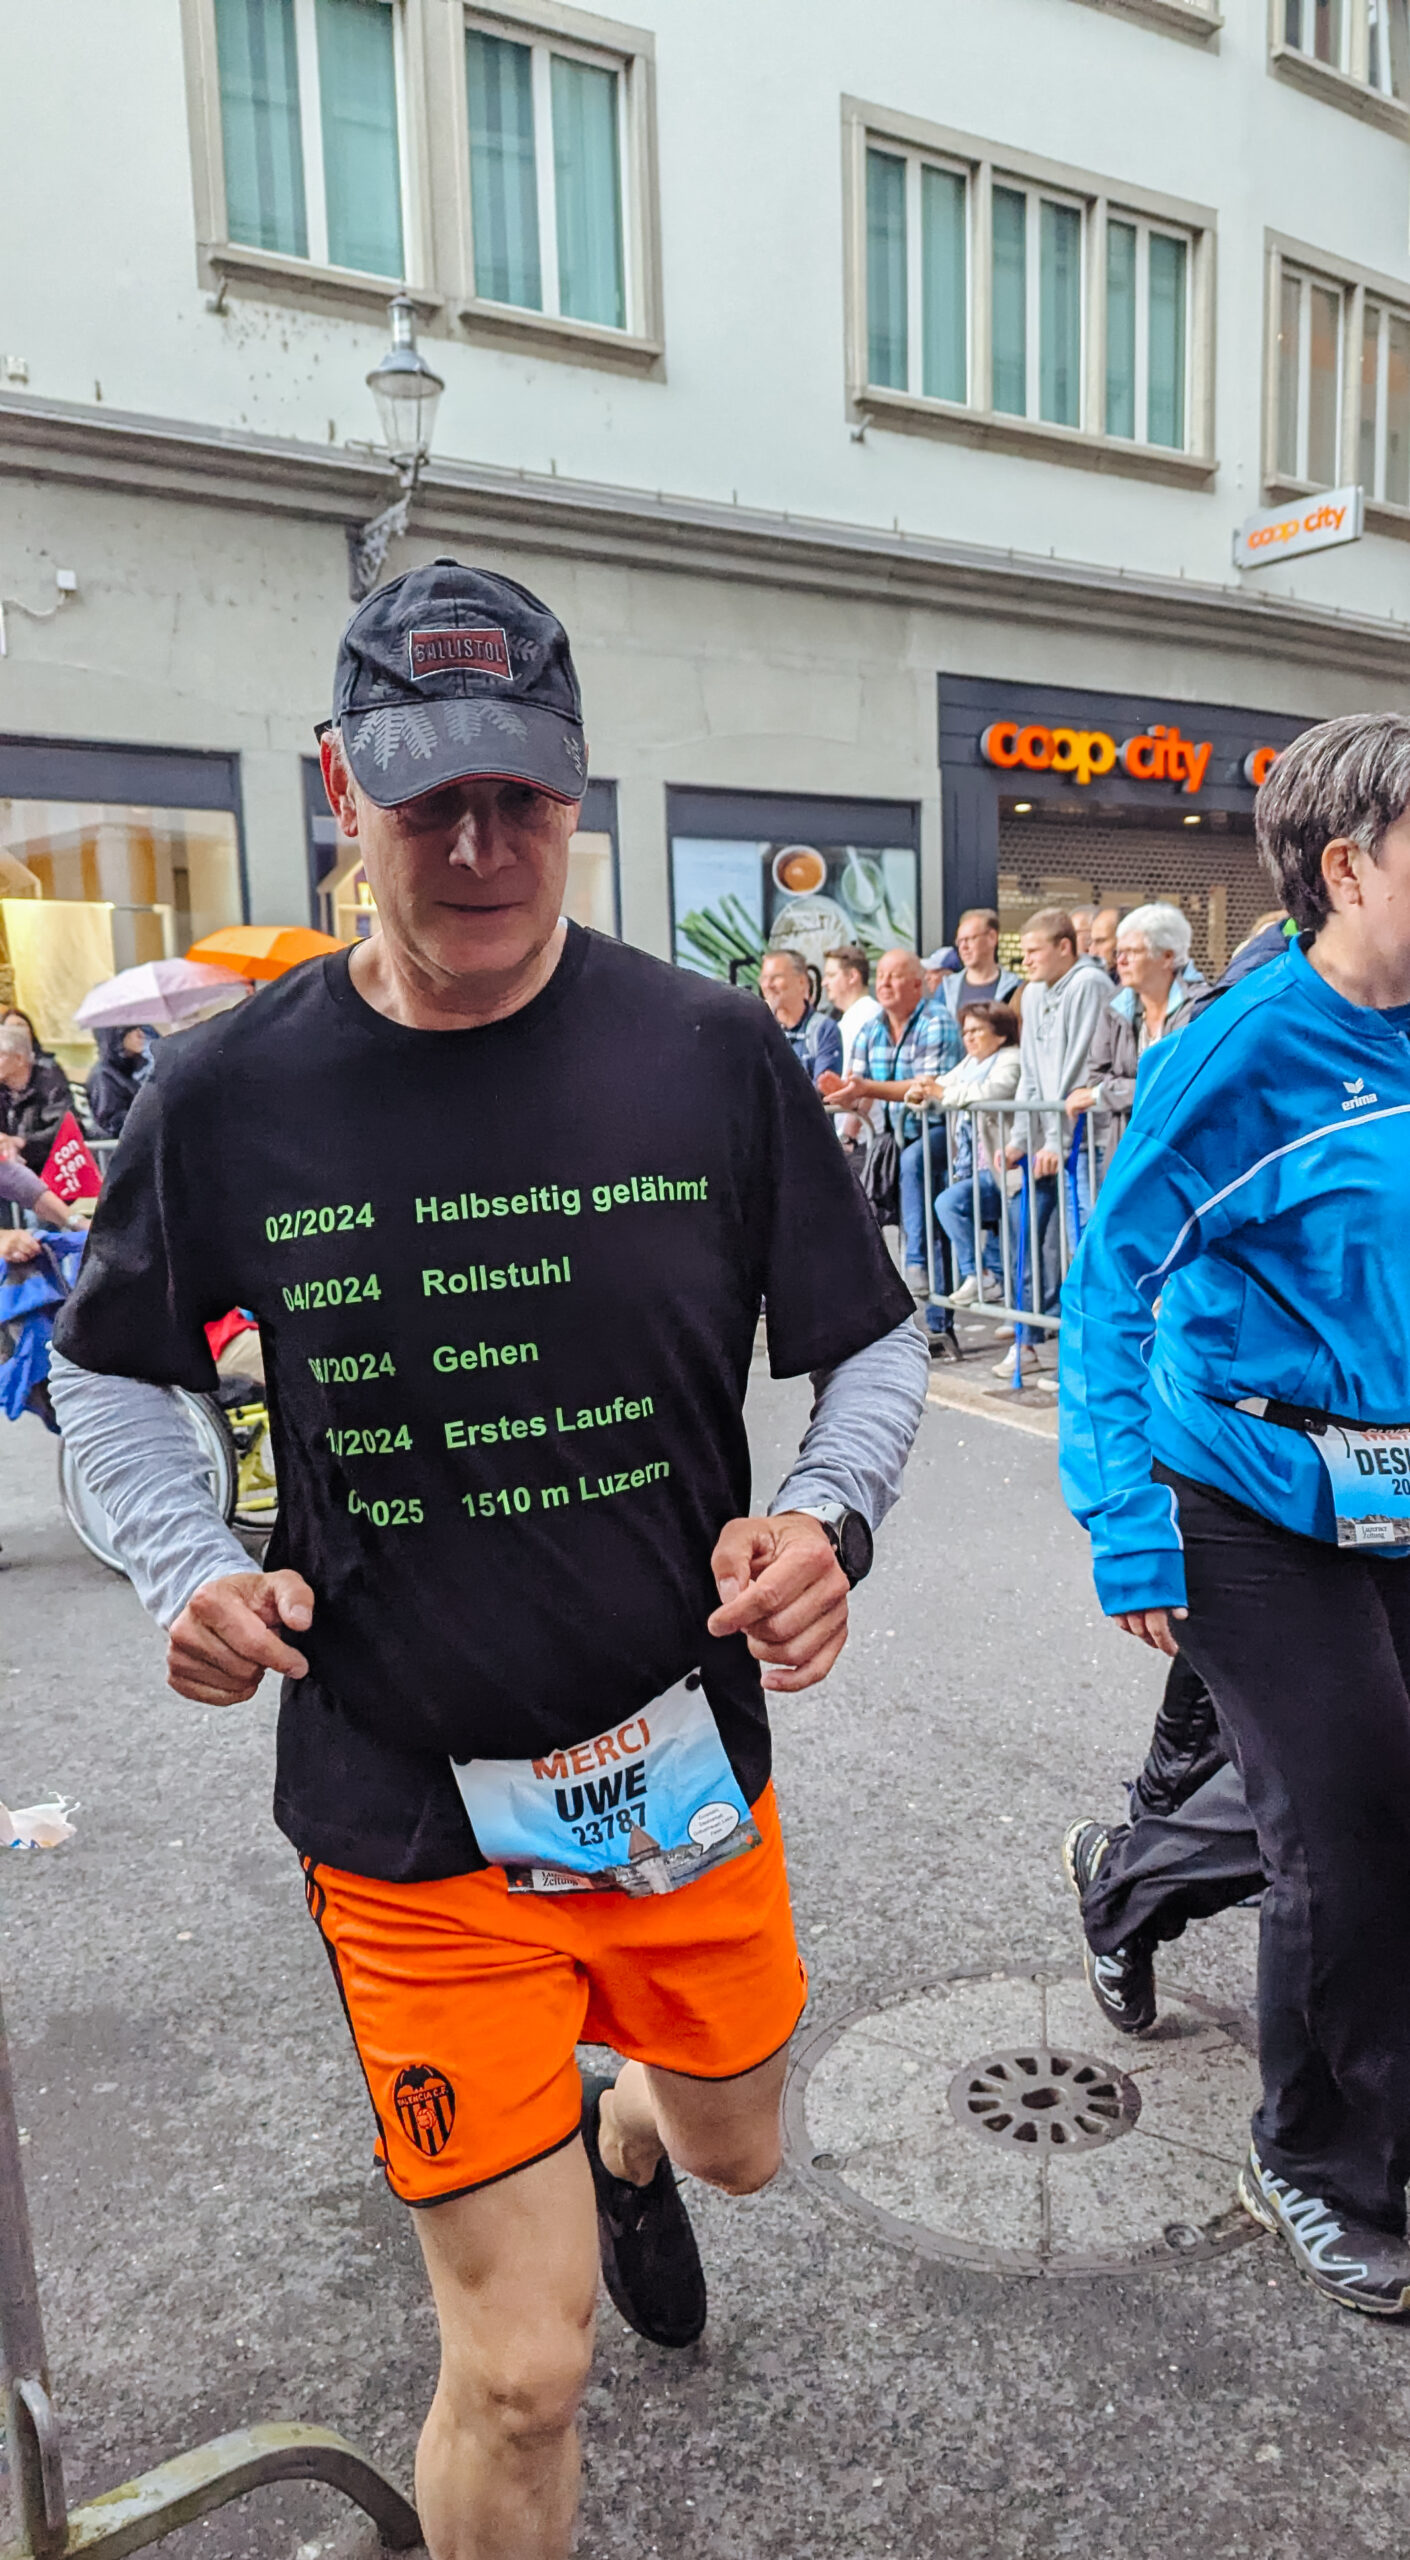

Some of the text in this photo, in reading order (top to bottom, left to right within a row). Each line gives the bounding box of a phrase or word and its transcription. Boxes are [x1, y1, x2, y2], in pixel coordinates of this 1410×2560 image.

[1247, 504, 1347, 551] coop city
[984, 721, 1117, 785] coop
[1122, 724, 1213, 794] city
[1341, 1093, 1378, 1111] erima
[54, 1139, 80, 1165] con
[265, 1175, 709, 1242] 02/2024 Halbseitig gelähmt
[282, 1256, 572, 1312] 04/2024 Rollstuhl
[433, 1341, 539, 1372] Gehen
[326, 1396, 655, 1456] 1/2024 Erstes Laufen
[461, 1487, 531, 1517] 1510
[541, 1485, 570, 1509] m
[578, 1461, 670, 1501] Luzern
[531, 1717, 651, 1780] MERCI
[554, 1759, 648, 1822] UWE
[571, 1801, 646, 1847] 23787
